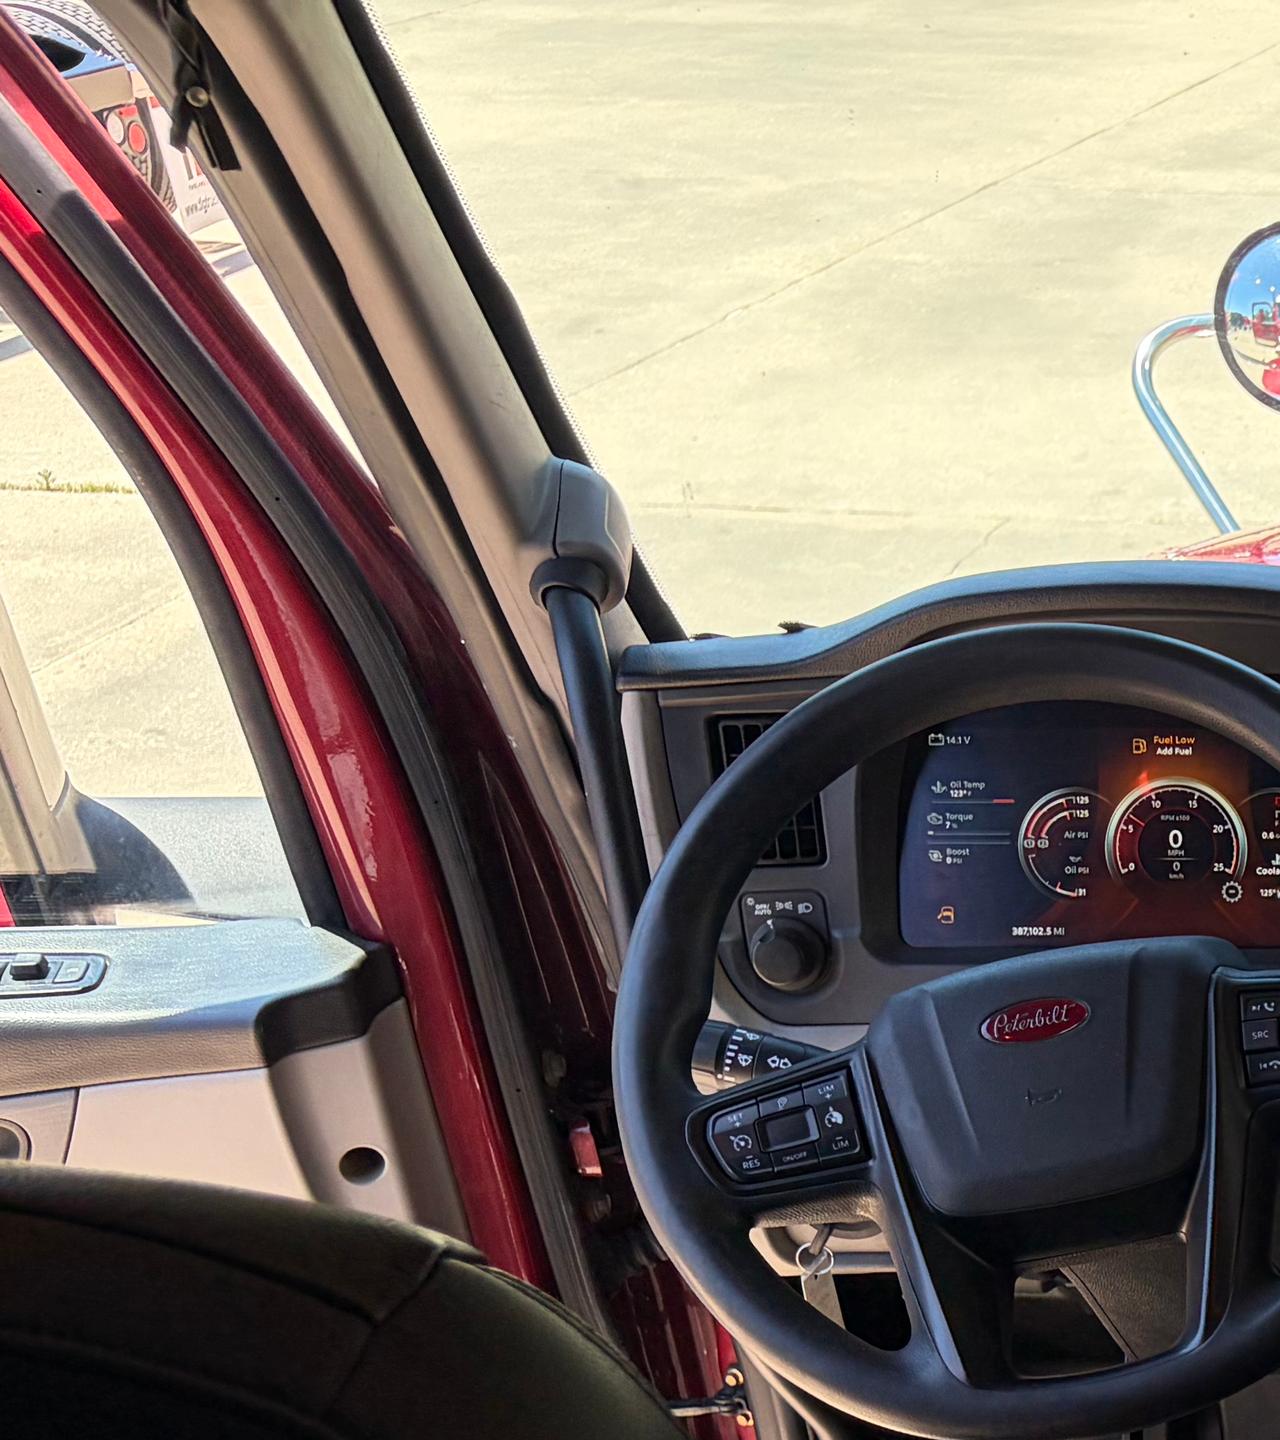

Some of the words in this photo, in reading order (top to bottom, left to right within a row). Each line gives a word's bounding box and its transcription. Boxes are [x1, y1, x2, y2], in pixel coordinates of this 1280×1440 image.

[963, 736, 971, 744] V
[1153, 735, 1173, 744] Fuel
[1175, 736, 1196, 744] Low
[1156, 747, 1173, 755] Add
[1174, 747, 1192, 755] Fuel
[950, 781, 962, 789] Oil
[963, 781, 986, 791] Temp
[1151, 800, 1161, 808] 10
[1188, 800, 1198, 808] 15
[946, 813, 974, 822] Torque
[1128, 825, 1134, 833] 5
[1213, 824, 1224, 833] 20
[1063, 831, 1075, 839] Air
[1077, 831, 1089, 839] PSI
[1168, 829, 1183, 849] 0
[1261, 832, 1274, 840] 0.6
[946, 848, 970, 856] Boost
[1064, 866, 1077, 874] Oil
[1077, 866, 1089, 874] PSI
[1128, 863, 1135, 871] 0
[1173, 861, 1180, 872] 0
[1213, 863, 1224, 871] 25
[1053, 927, 1065, 936] MI
[993, 1003, 1076, 1039] Peterbilt
[1251, 1029, 1269, 1040] SRC
[817, 1084, 834, 1095] LIM
[727, 1112, 743, 1123] SET
[832, 1139, 849, 1151] LIM
[782, 1151, 807, 1162] ON/OFF
[742, 1158, 761, 1169] RES
